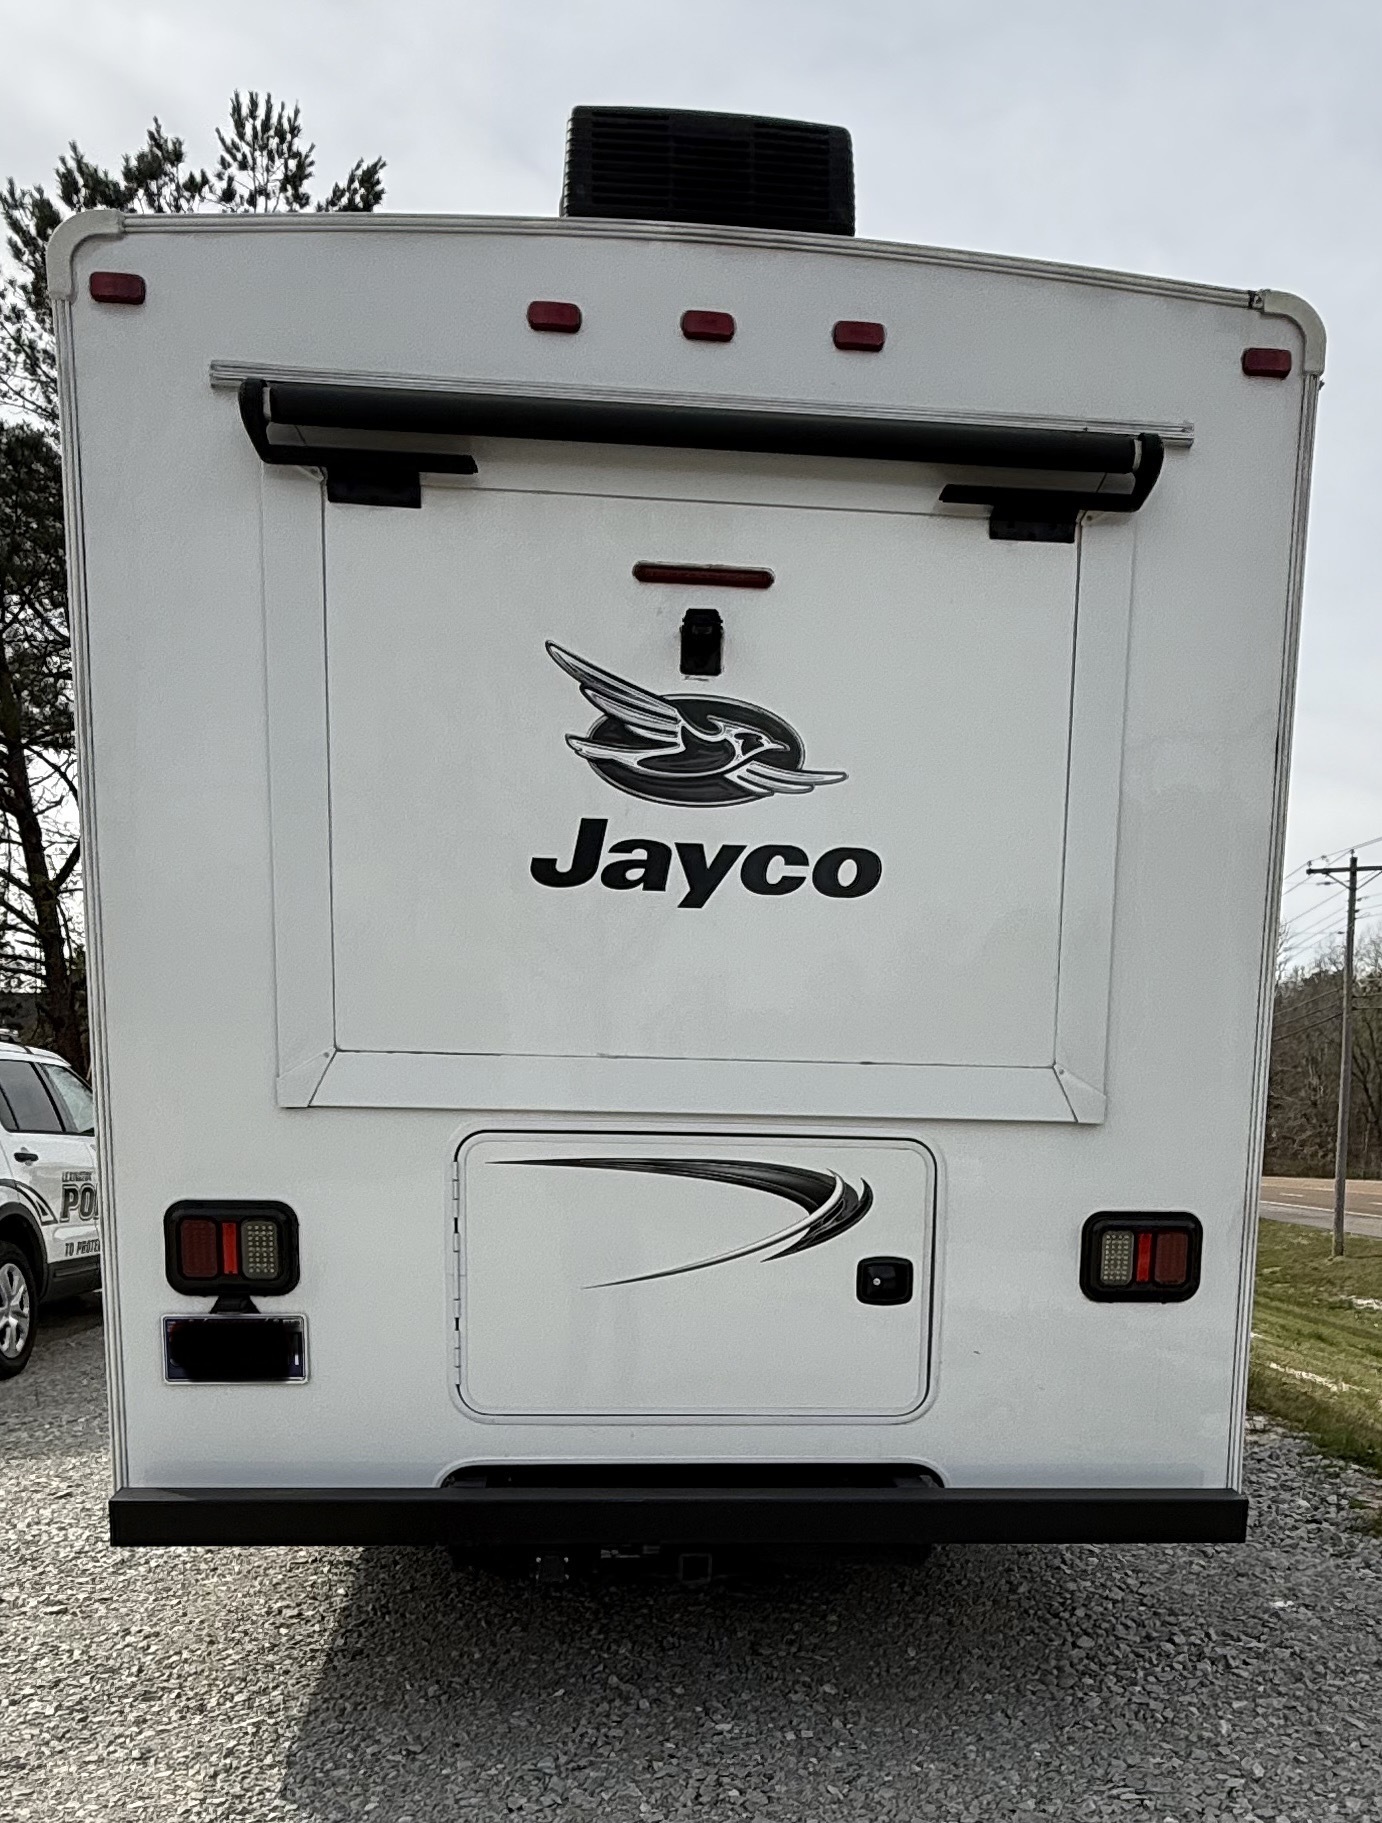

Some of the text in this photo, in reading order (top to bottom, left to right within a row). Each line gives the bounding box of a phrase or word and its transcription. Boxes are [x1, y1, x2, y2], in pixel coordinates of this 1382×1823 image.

[530, 818, 882, 908] Jayco
[65, 1239, 100, 1256] TO PROTE
